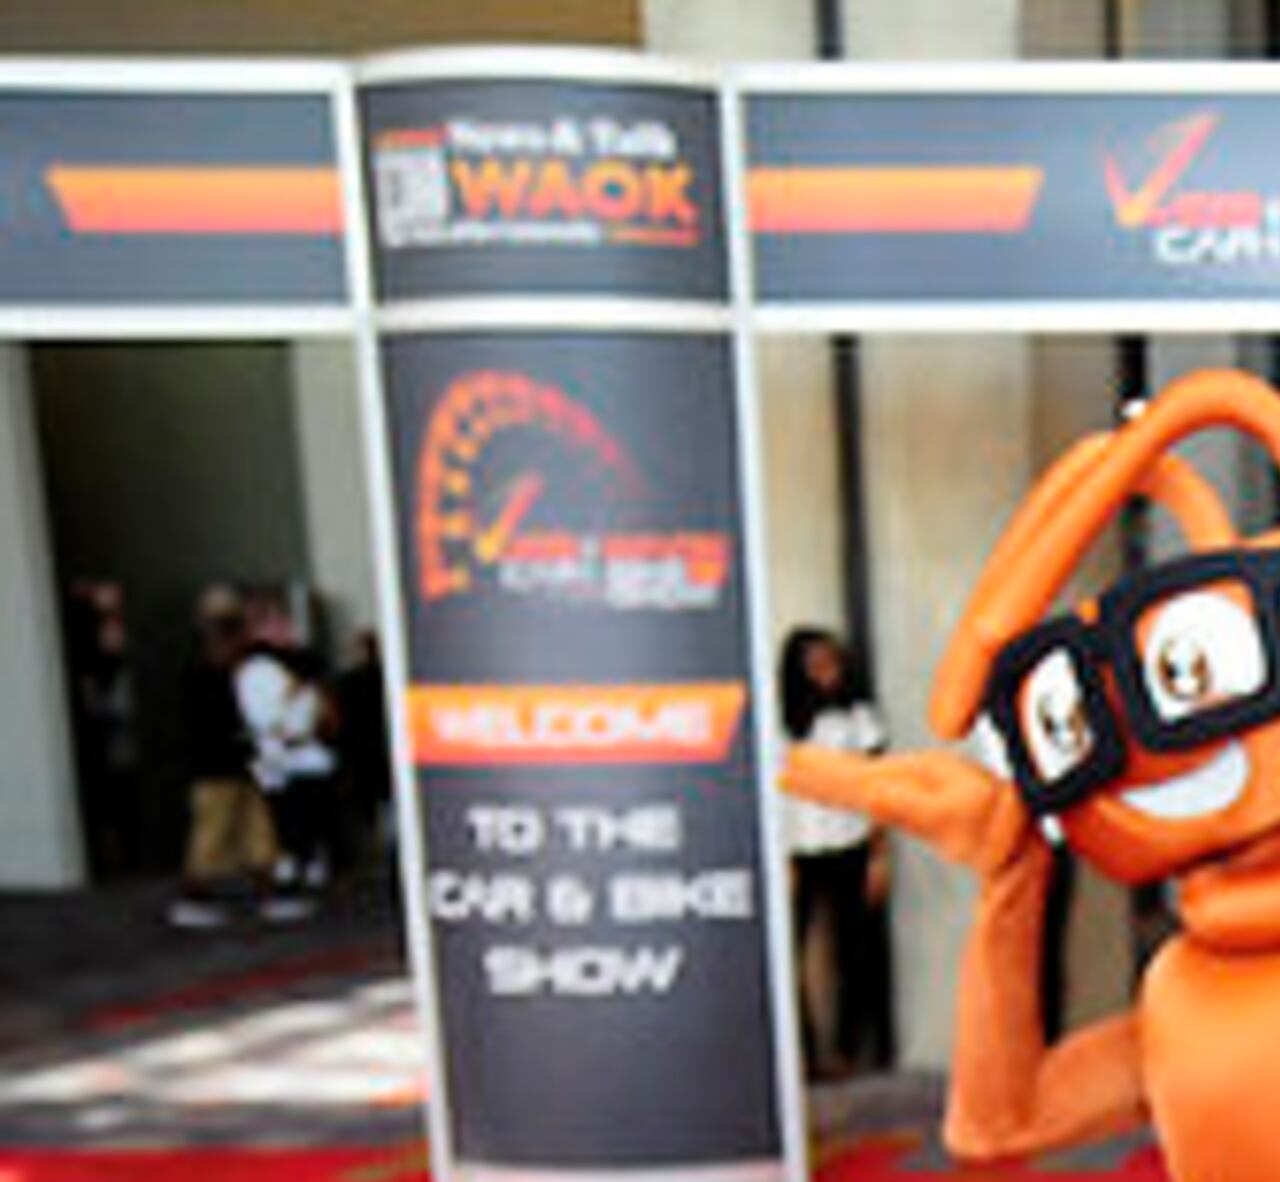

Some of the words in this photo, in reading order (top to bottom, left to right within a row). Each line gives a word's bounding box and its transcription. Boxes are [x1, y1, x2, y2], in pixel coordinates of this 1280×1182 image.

[447, 156, 699, 225] WAOK
[430, 702, 713, 748] WELCOME
[467, 805, 544, 854] TO
[555, 805, 682, 851] THE
[430, 871, 534, 923] CAR
[546, 876, 594, 925] &
[611, 868, 754, 922] BIKE
[482, 944, 684, 994] SHOW
